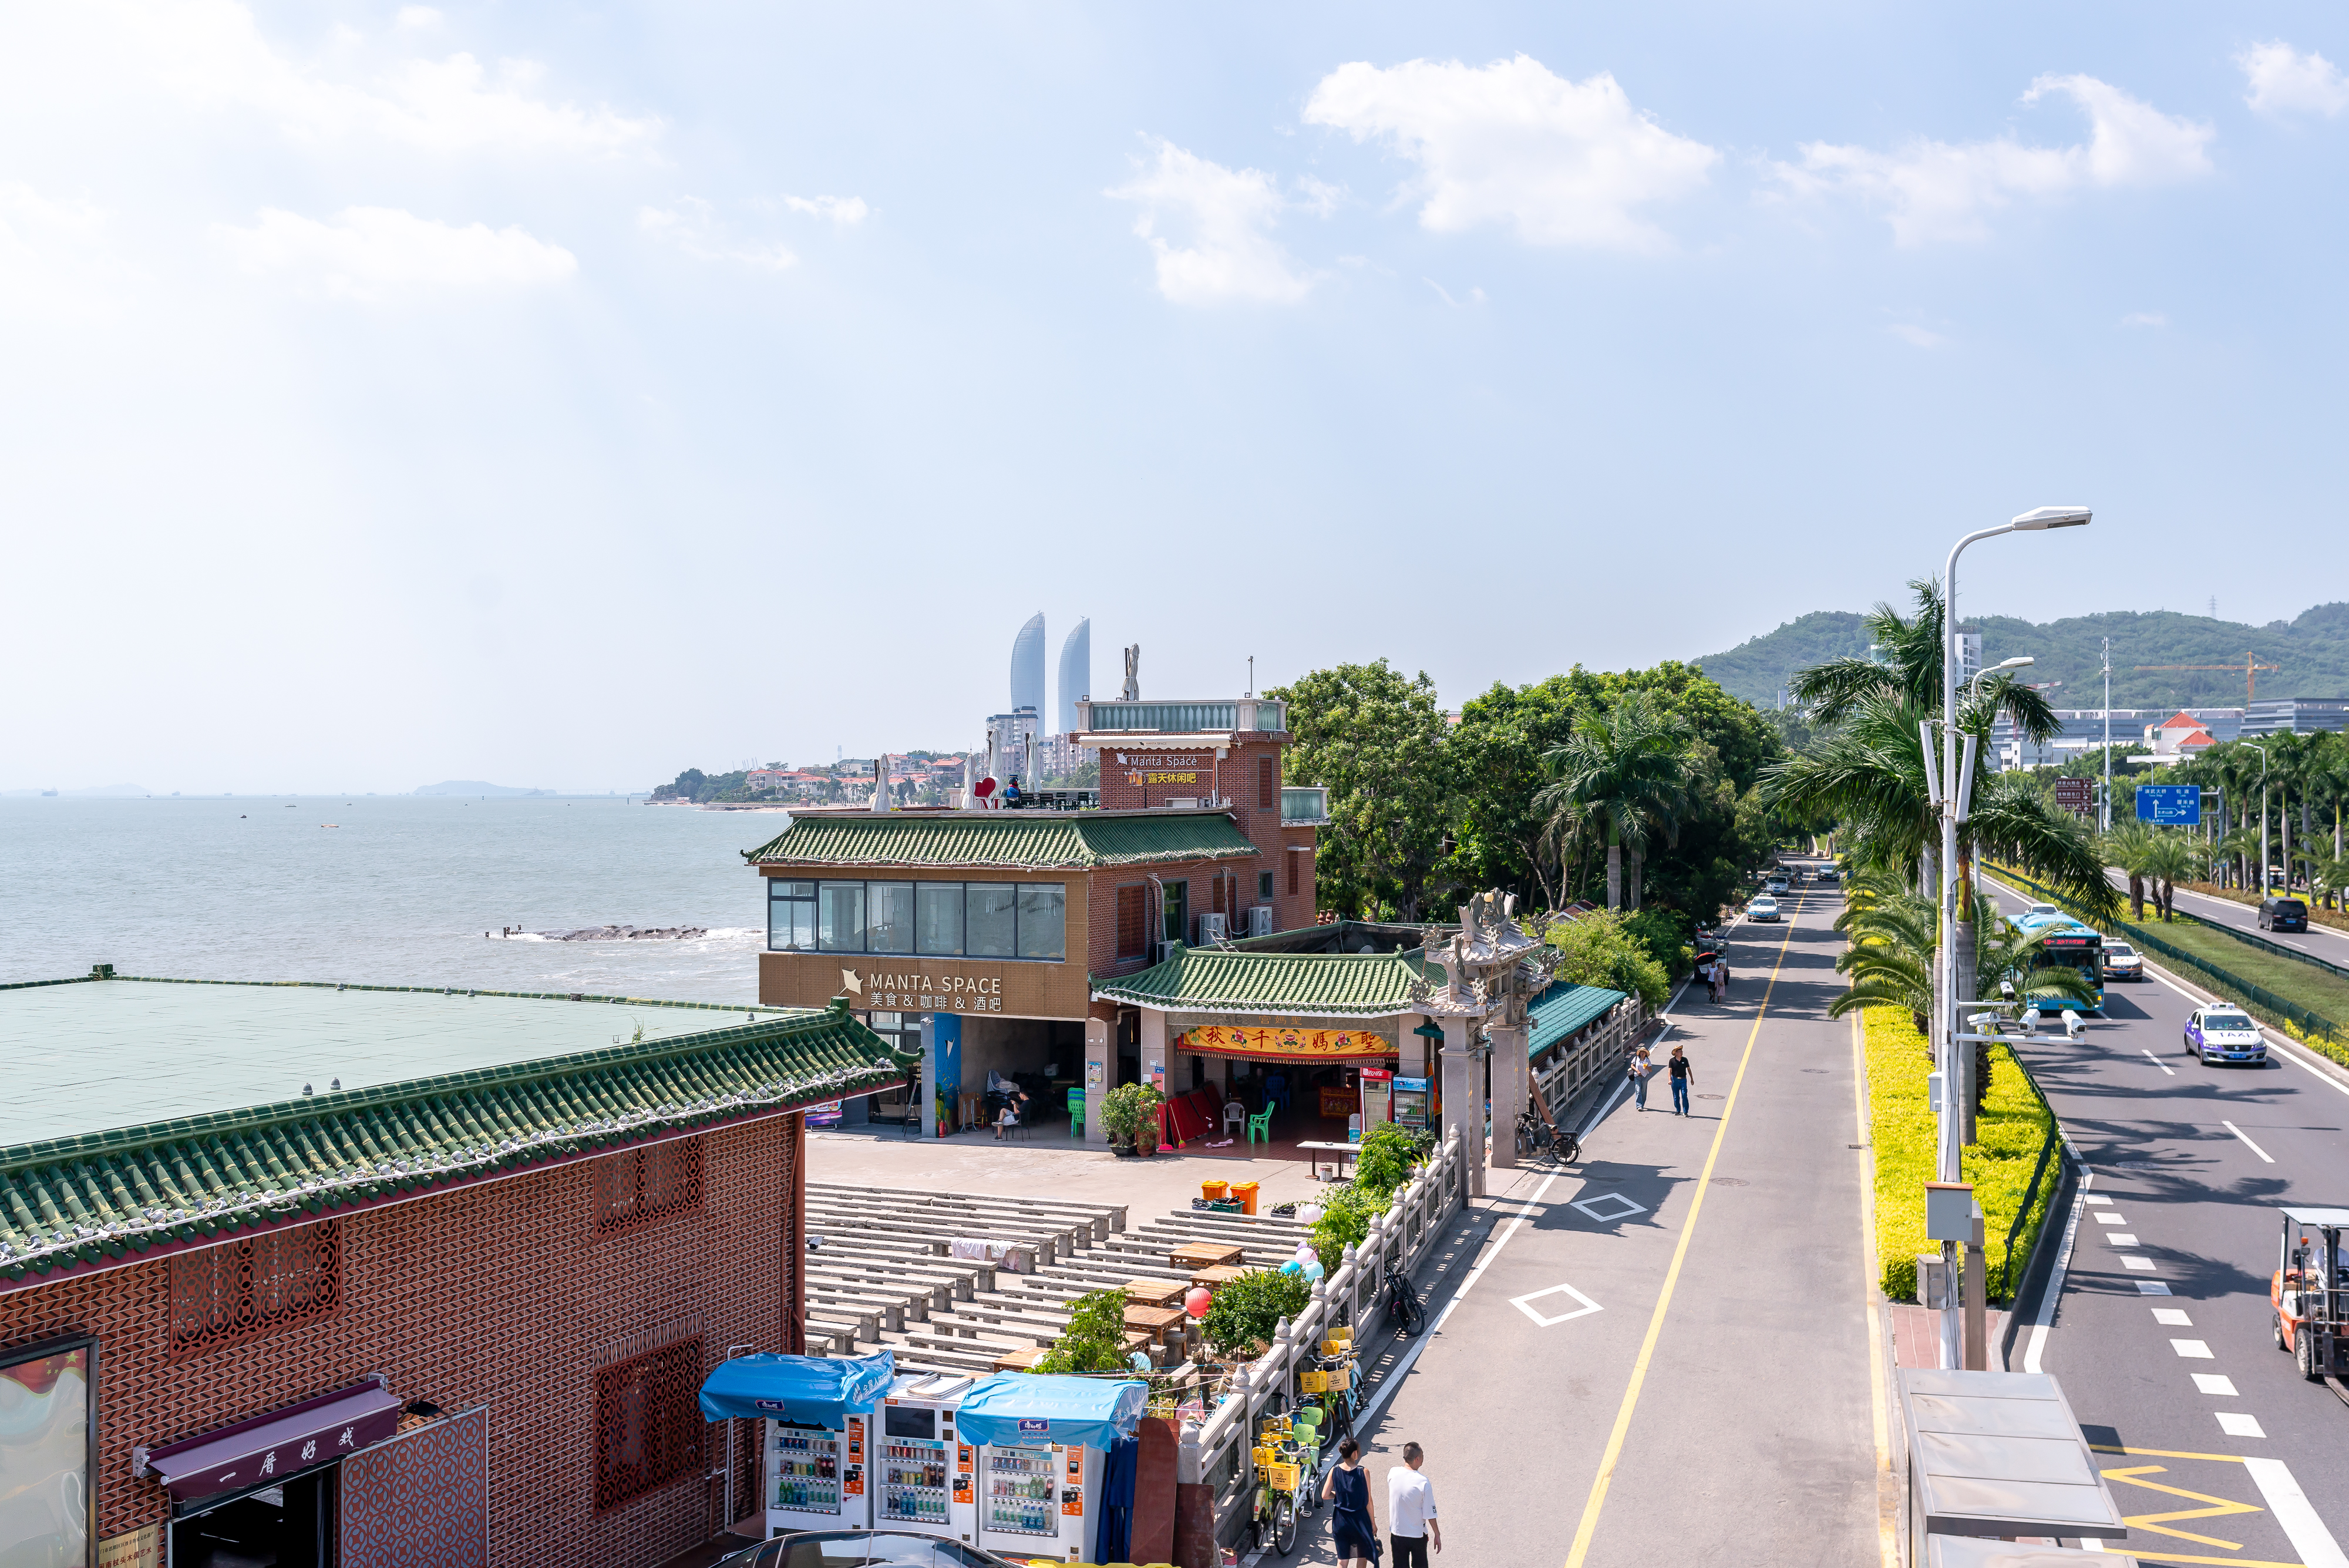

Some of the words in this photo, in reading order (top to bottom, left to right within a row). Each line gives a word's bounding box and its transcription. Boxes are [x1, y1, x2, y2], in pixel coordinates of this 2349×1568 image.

[1131, 756, 1161, 766] Manta
[1167, 756, 1197, 768] Space
[1148, 773, 1196, 784] 露天休闲吧
[870, 973, 933, 991] MANTA
[942, 976, 1001, 994] SPACE
[870, 991, 897, 1007] 美食
[903, 995, 914, 1007] &
[920, 994, 947, 1010] 咖啡
[955, 997, 966, 1010] &
[973, 996, 1001, 1012] 酒吧
